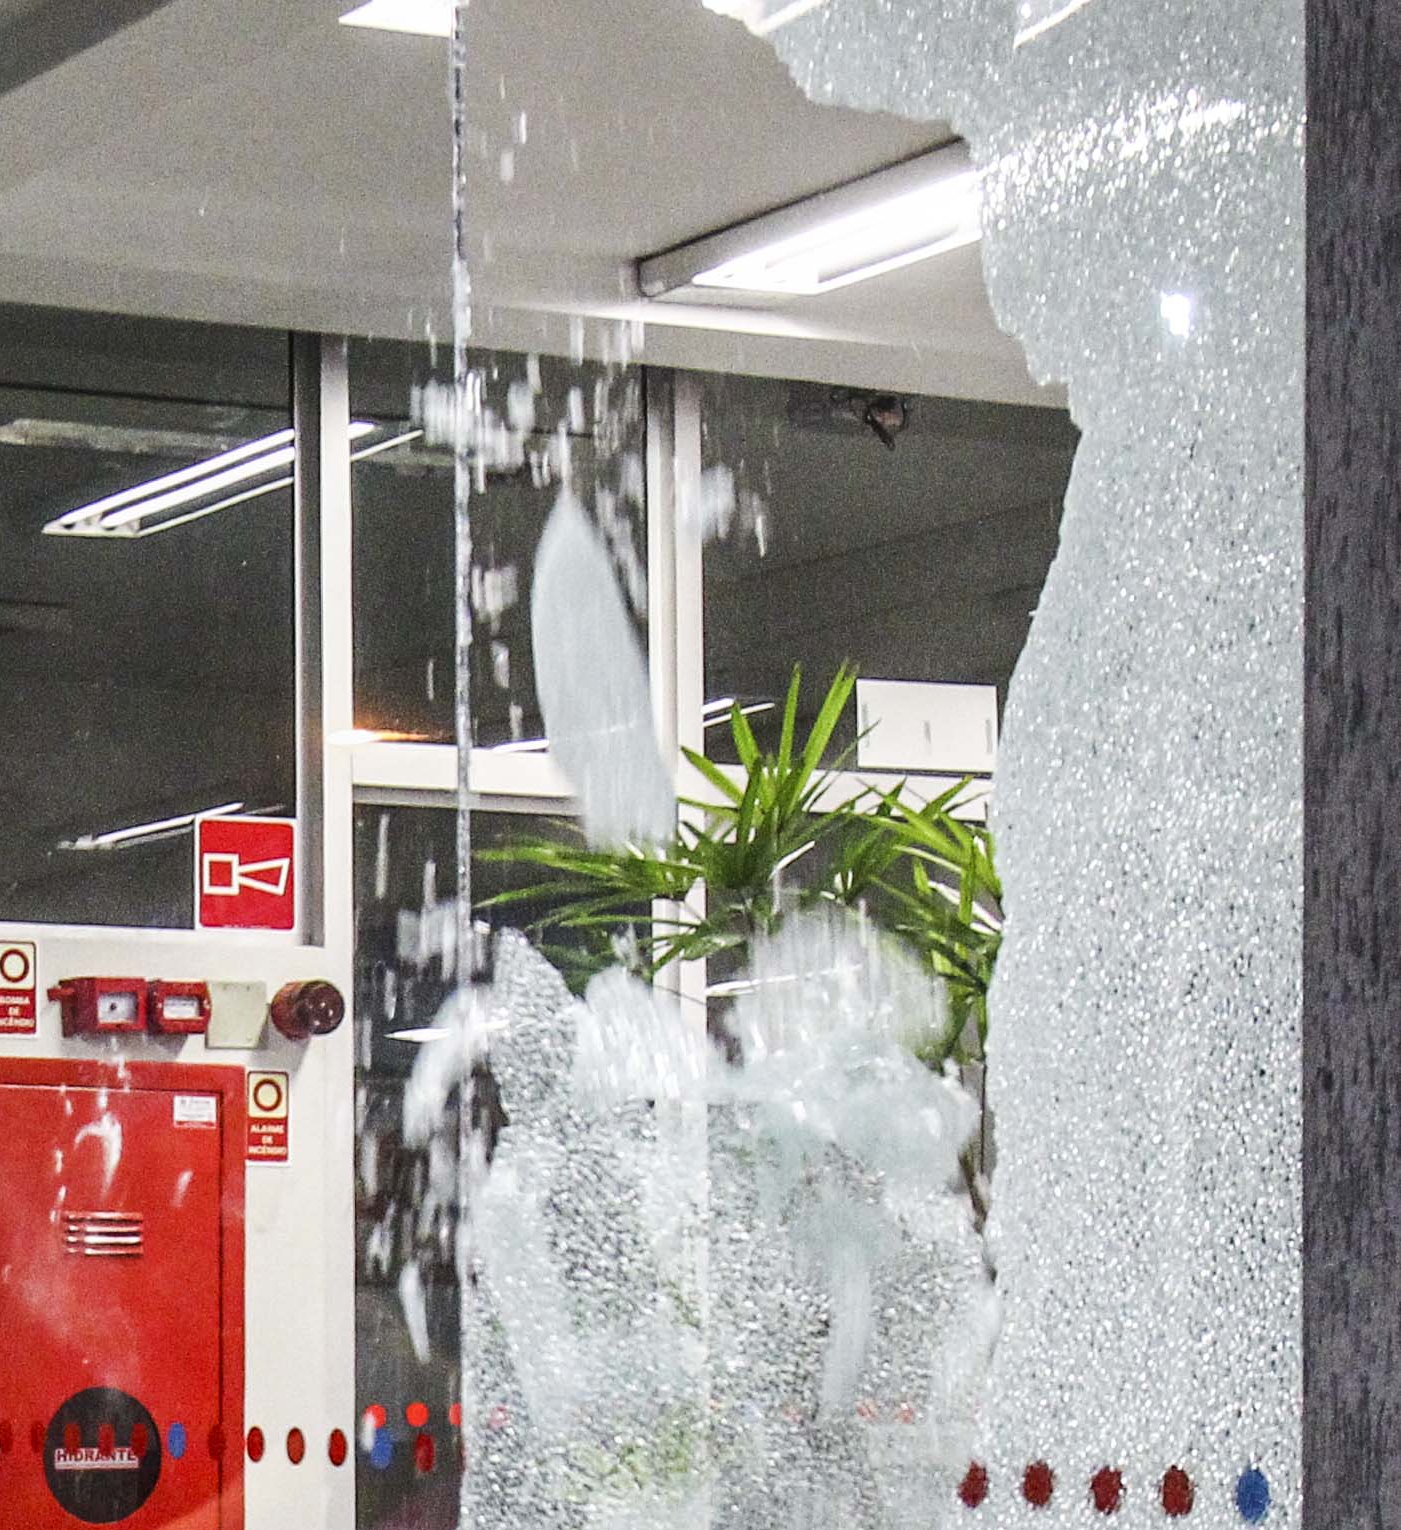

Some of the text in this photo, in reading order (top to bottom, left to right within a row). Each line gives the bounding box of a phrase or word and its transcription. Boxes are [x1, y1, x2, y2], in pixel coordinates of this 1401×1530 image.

[8, 1006, 21, 1016] DE
[250, 1124, 285, 1134] ALARME
[261, 1135, 274, 1145] DE
[56, 1448, 138, 1462] HIDRANTE
